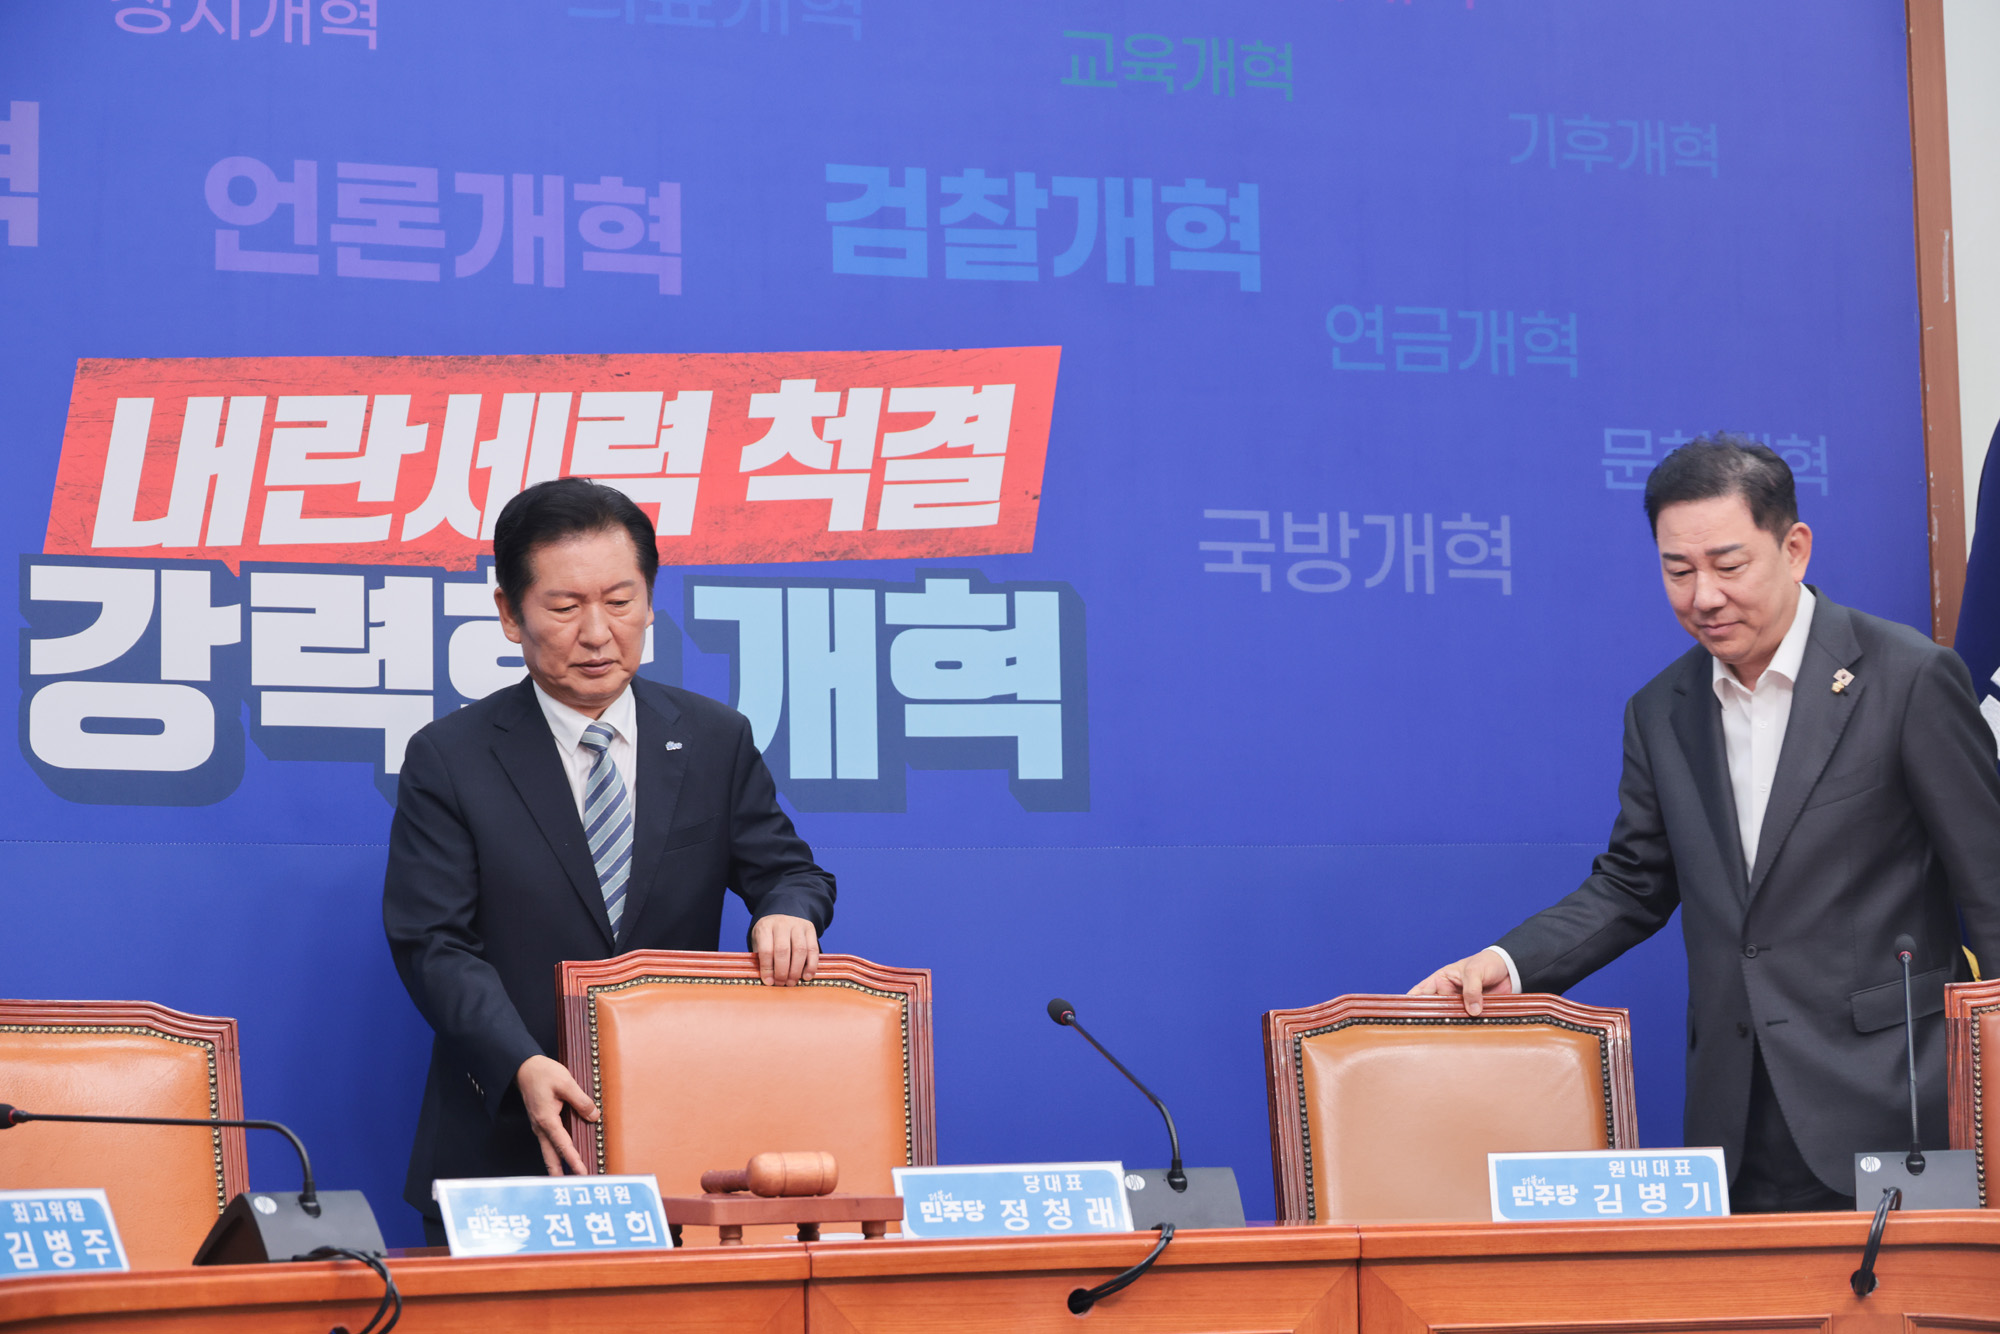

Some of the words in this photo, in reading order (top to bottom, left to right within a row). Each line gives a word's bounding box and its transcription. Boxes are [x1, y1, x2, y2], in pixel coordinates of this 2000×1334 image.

[1061, 30, 1293, 102] 교육개혁
[1509, 113, 1718, 179] 기후개혁
[204, 156, 682, 296] 언론개혁
[825, 163, 1261, 292] 검찰개혁
[1325, 304, 1579, 378] 연금개혁
[90, 389, 712, 548] 내란세력
[739, 378, 1016, 532] 척결
[1602, 428, 1828, 496] 문혁
[1199, 508, 1513, 596] 국방개혁
[693, 578, 1063, 780] 개혁
[553, 1185, 631, 1206] 최고위원
[1023, 1174, 1083, 1193] 당대표
[1512, 1184, 1579, 1206] 민주당
[1594, 1182, 1712, 1214] 김병기
[1608, 1159, 1692, 1178] 원내대표
[11, 1200, 86, 1224] 최고위원
[466, 1214, 531, 1239] 민주당
[544, 1210, 657, 1247] 전현희
[920, 1199, 985, 1223] 민주당
[1000, 1197, 1116, 1231] 정청래
[4, 1229, 111, 1270] 김병주
